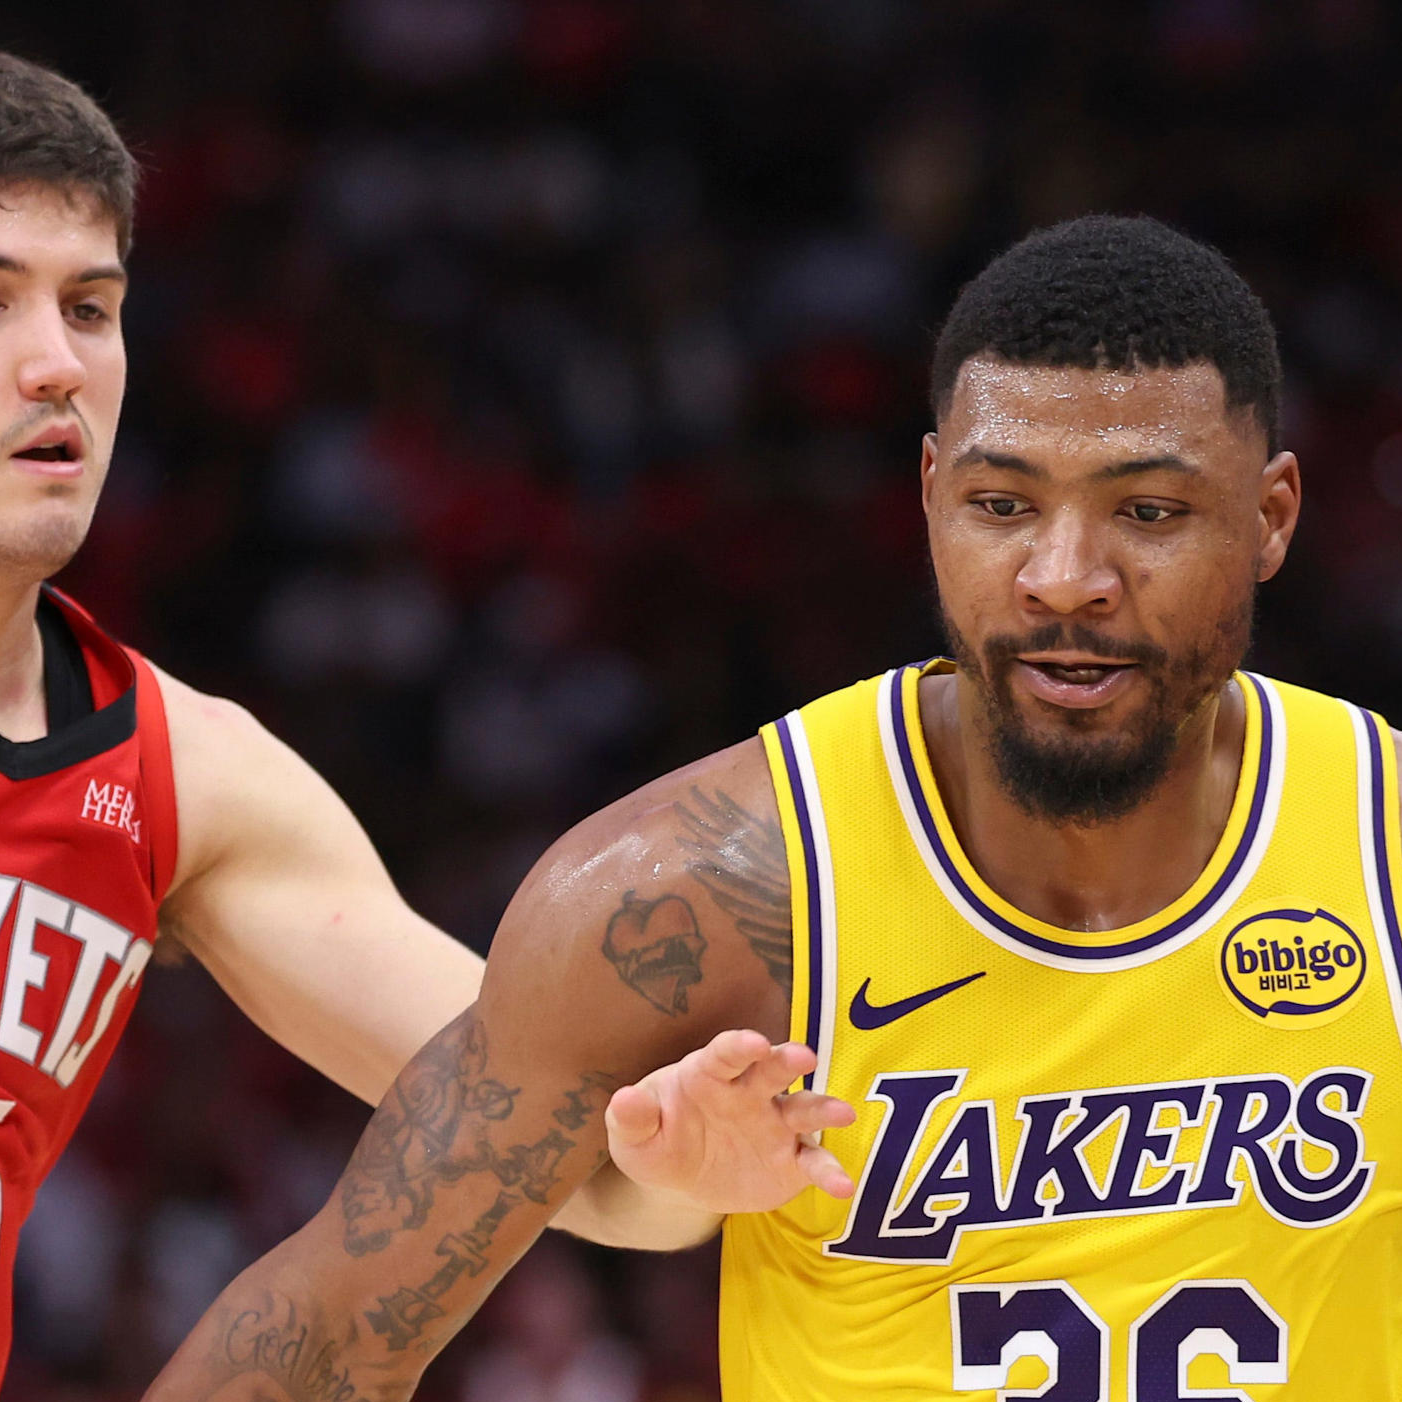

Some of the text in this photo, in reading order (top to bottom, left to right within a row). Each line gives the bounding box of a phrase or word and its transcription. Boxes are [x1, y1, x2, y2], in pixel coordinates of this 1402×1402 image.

[1233, 936, 1357, 981] bibigo
[1259, 973, 1311, 992] 비비고
[822, 1066, 1377, 1265] LAKERS
